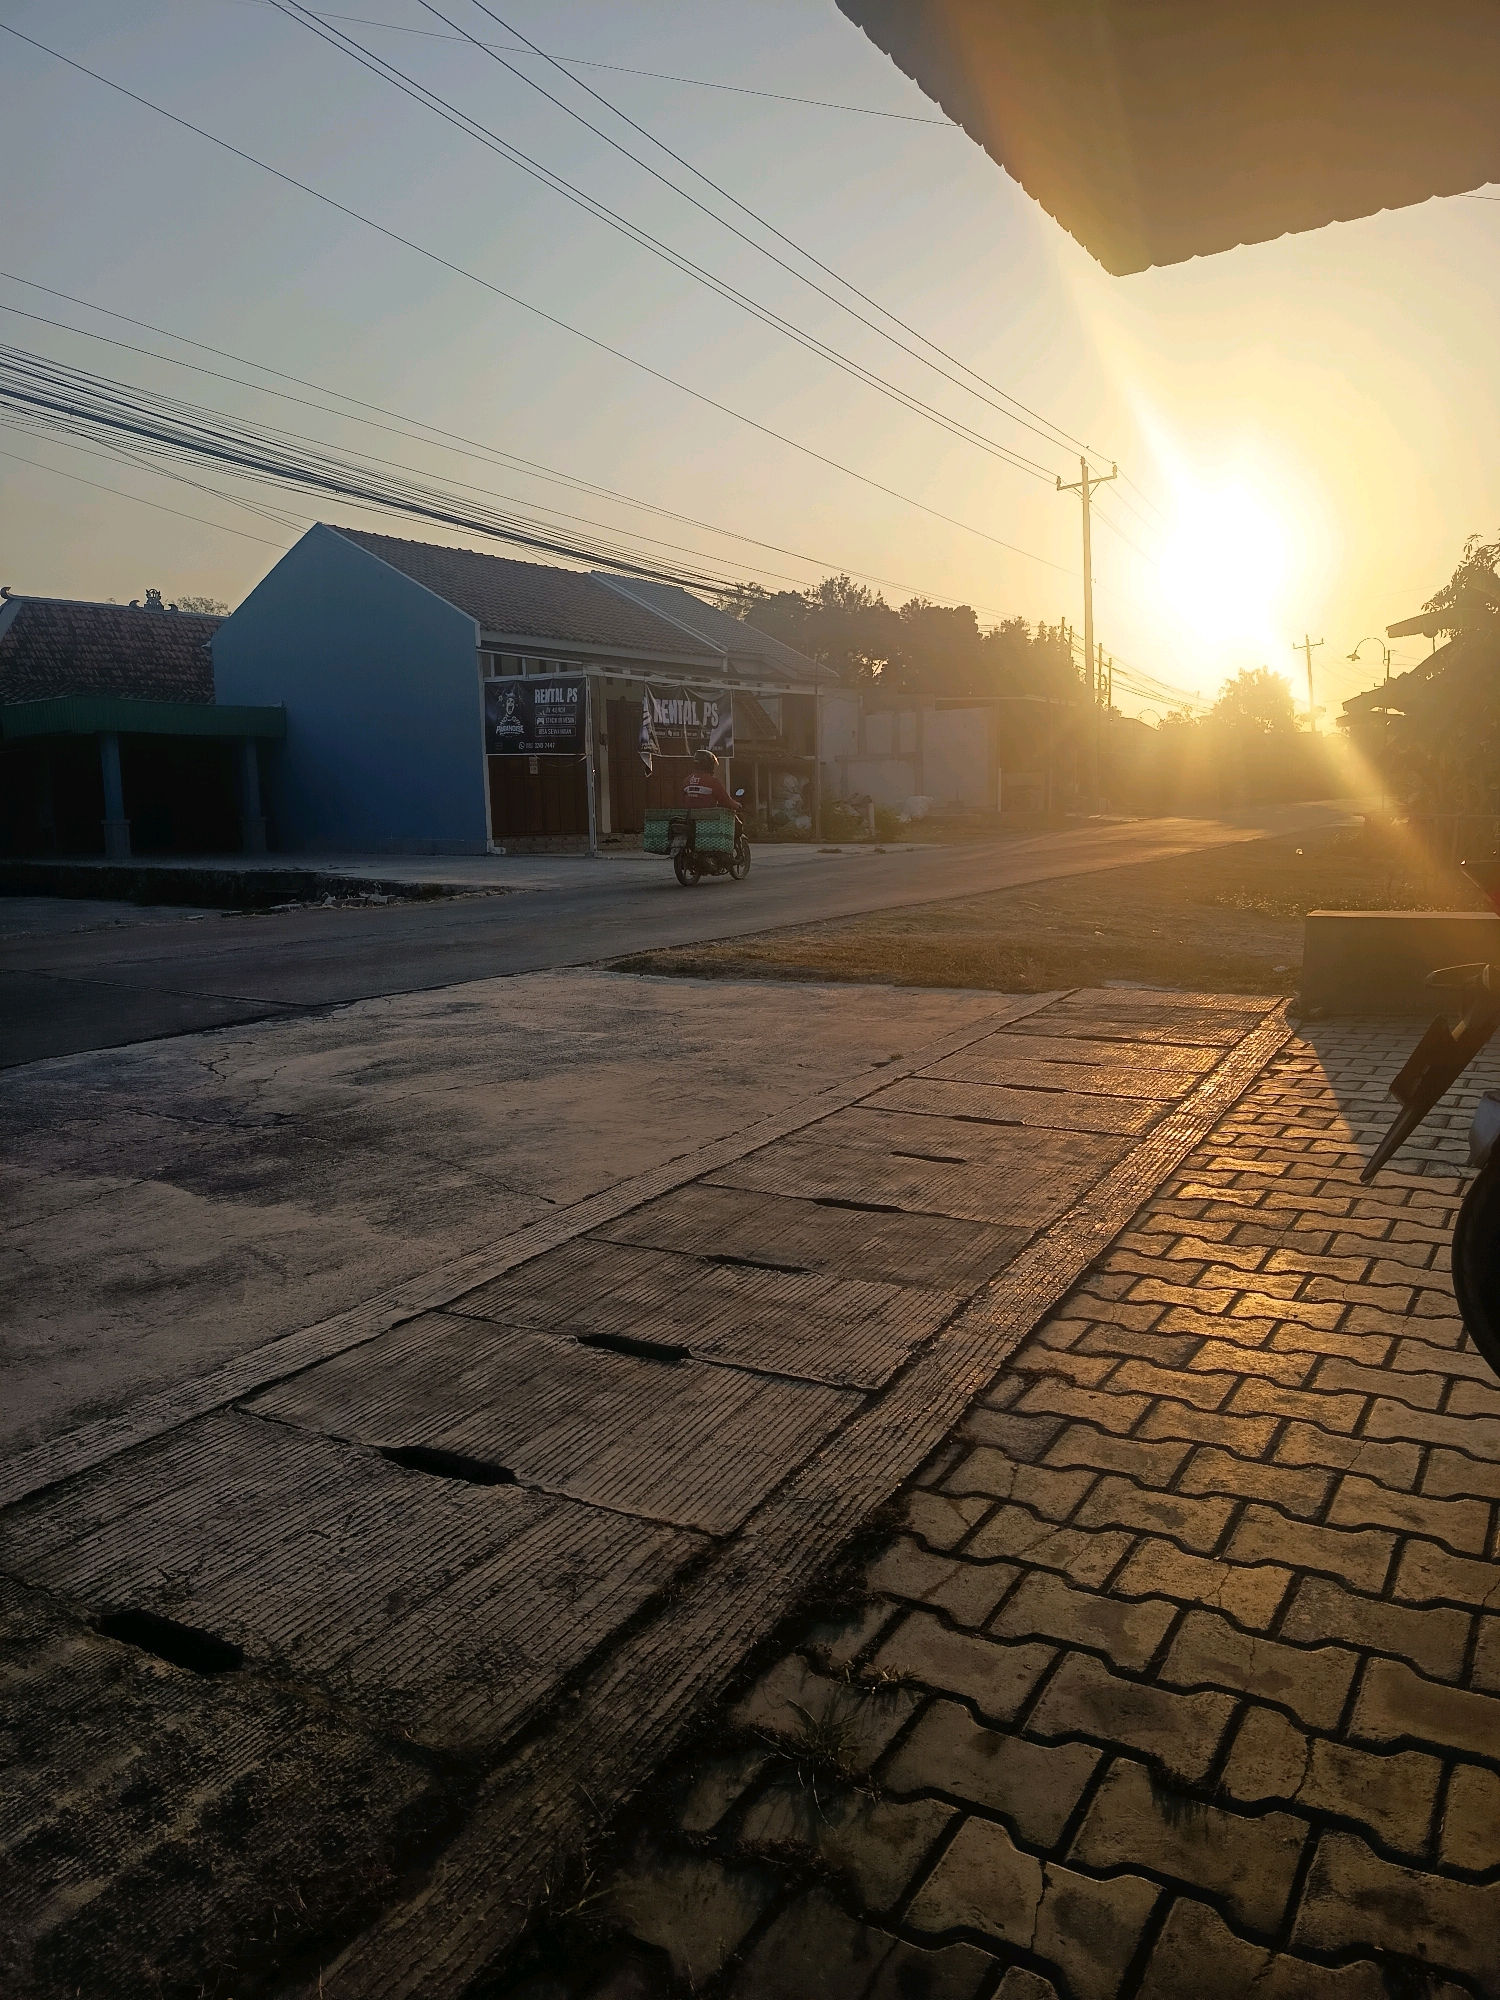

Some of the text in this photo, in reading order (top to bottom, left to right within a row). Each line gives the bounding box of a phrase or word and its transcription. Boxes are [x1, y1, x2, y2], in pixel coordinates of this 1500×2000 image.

[535, 688, 578, 703] RENTAL PS
[653, 698, 719, 727] RENTAL PS
